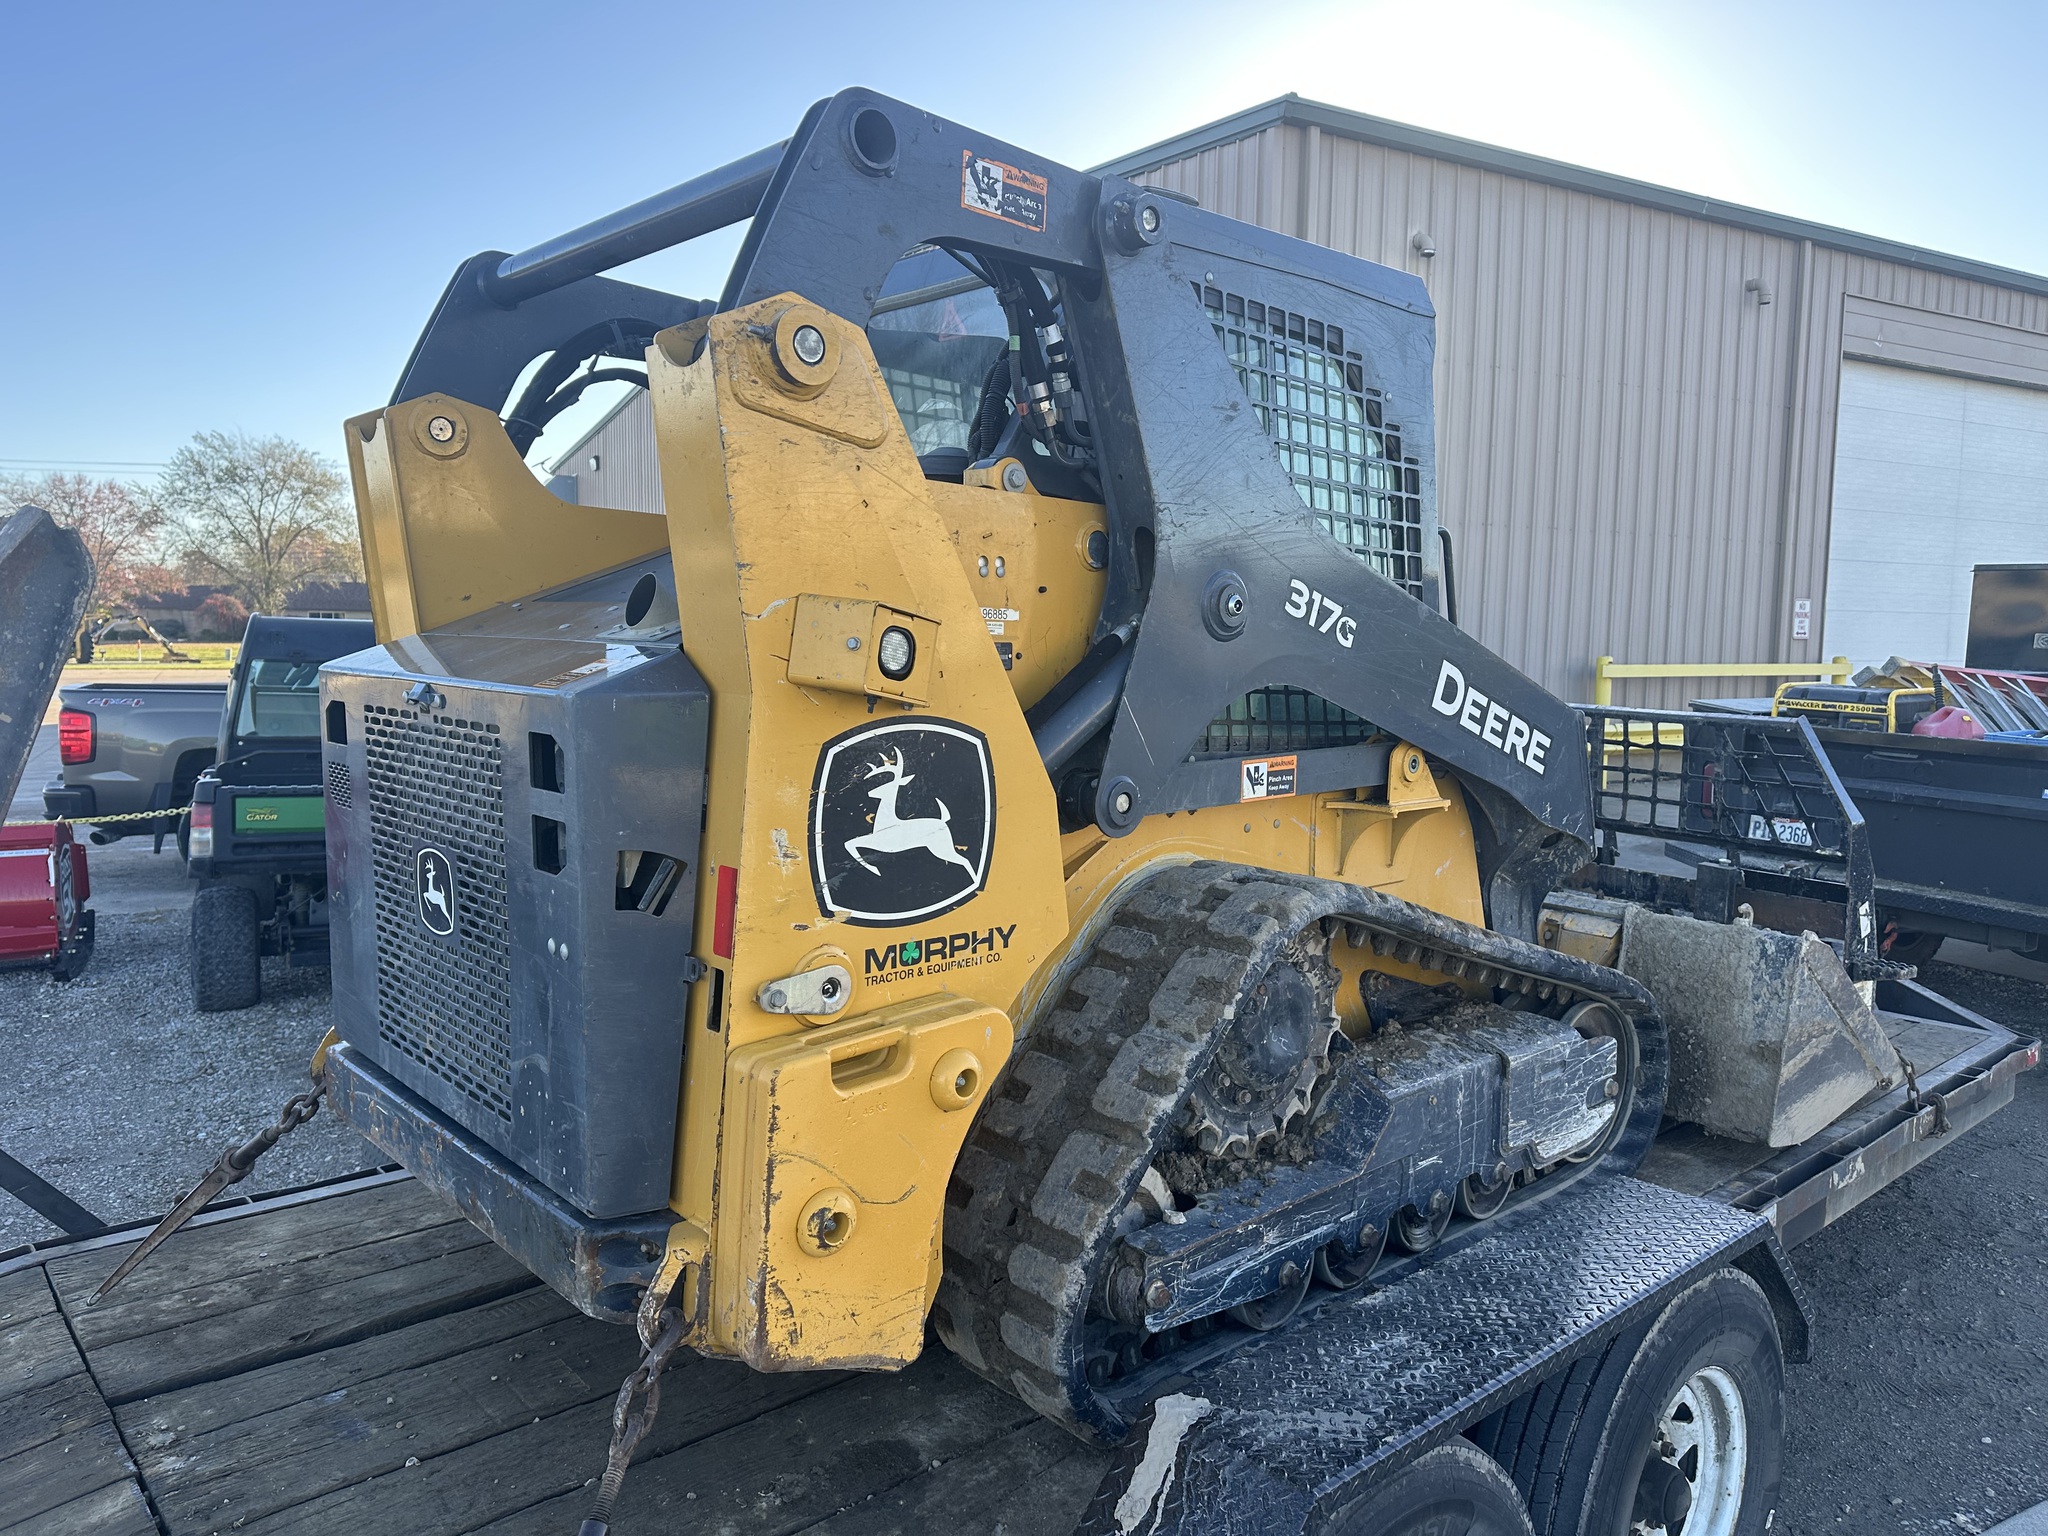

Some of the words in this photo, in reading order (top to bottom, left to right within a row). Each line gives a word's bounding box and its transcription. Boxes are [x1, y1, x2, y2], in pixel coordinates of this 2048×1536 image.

[1013, 172, 1045, 191] WNING
[982, 608, 1008, 619] 96885
[1284, 579, 1357, 649] 317G
[1791, 701, 1820, 709] WACKER
[1431, 659, 1552, 775] DEERE
[1268, 775, 1281, 783] Pinch
[246, 813, 278, 821] GATOR
[1752, 820, 1773, 840] PI
[1779, 824, 1808, 844] 2368
[865, 924, 1017, 974] MURPHY
[865, 967, 914, 987] TRACTOR
[917, 967, 924, 977] &
[927, 956, 983, 975] EQUIPMENT
[986, 952, 1003, 963] CO.
